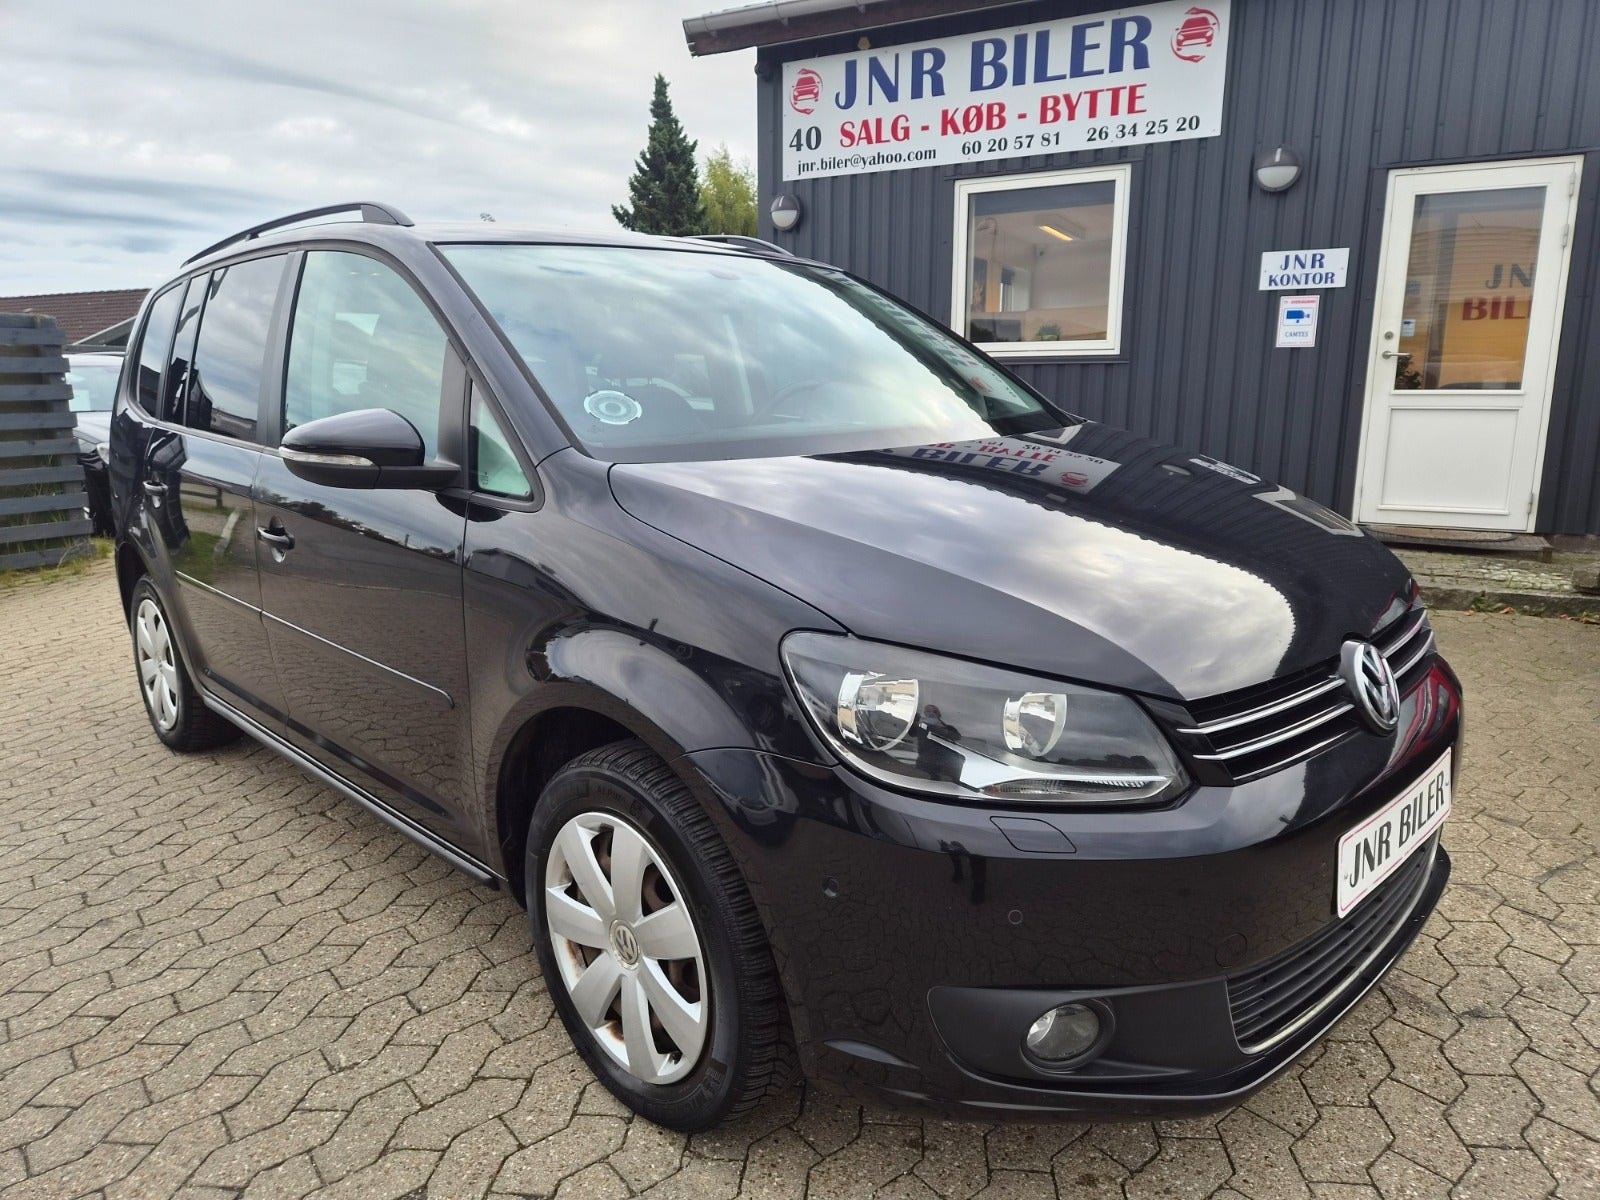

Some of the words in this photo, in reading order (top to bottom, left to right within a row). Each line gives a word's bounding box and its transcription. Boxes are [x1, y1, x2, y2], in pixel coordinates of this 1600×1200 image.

[835, 47, 945, 109] JNR
[970, 15, 1152, 92] BILER
[840, 114, 910, 147] SALG
[940, 101, 1007, 136] KØB
[1039, 83, 1147, 124] BYTTE
[789, 126, 822, 151] 40
[961, 140, 981, 155] 60
[987, 138, 1008, 152] 20
[1013, 134, 1034, 149] 57
[1040, 131, 1060, 147] 81
[1087, 125, 1109, 142] 26
[1115, 122, 1138, 139] 34
[1145, 119, 1168, 135] 25
[1176, 115, 1200, 132] 20
[798, 149, 936, 175] jnr.biler@yahoo.com
[1280, 253, 1325, 270] JNR
[1268, 272, 1335, 287] KONTOR
[1349, 821, 1391, 888] JNR
[1399, 770, 1444, 848] BILER
